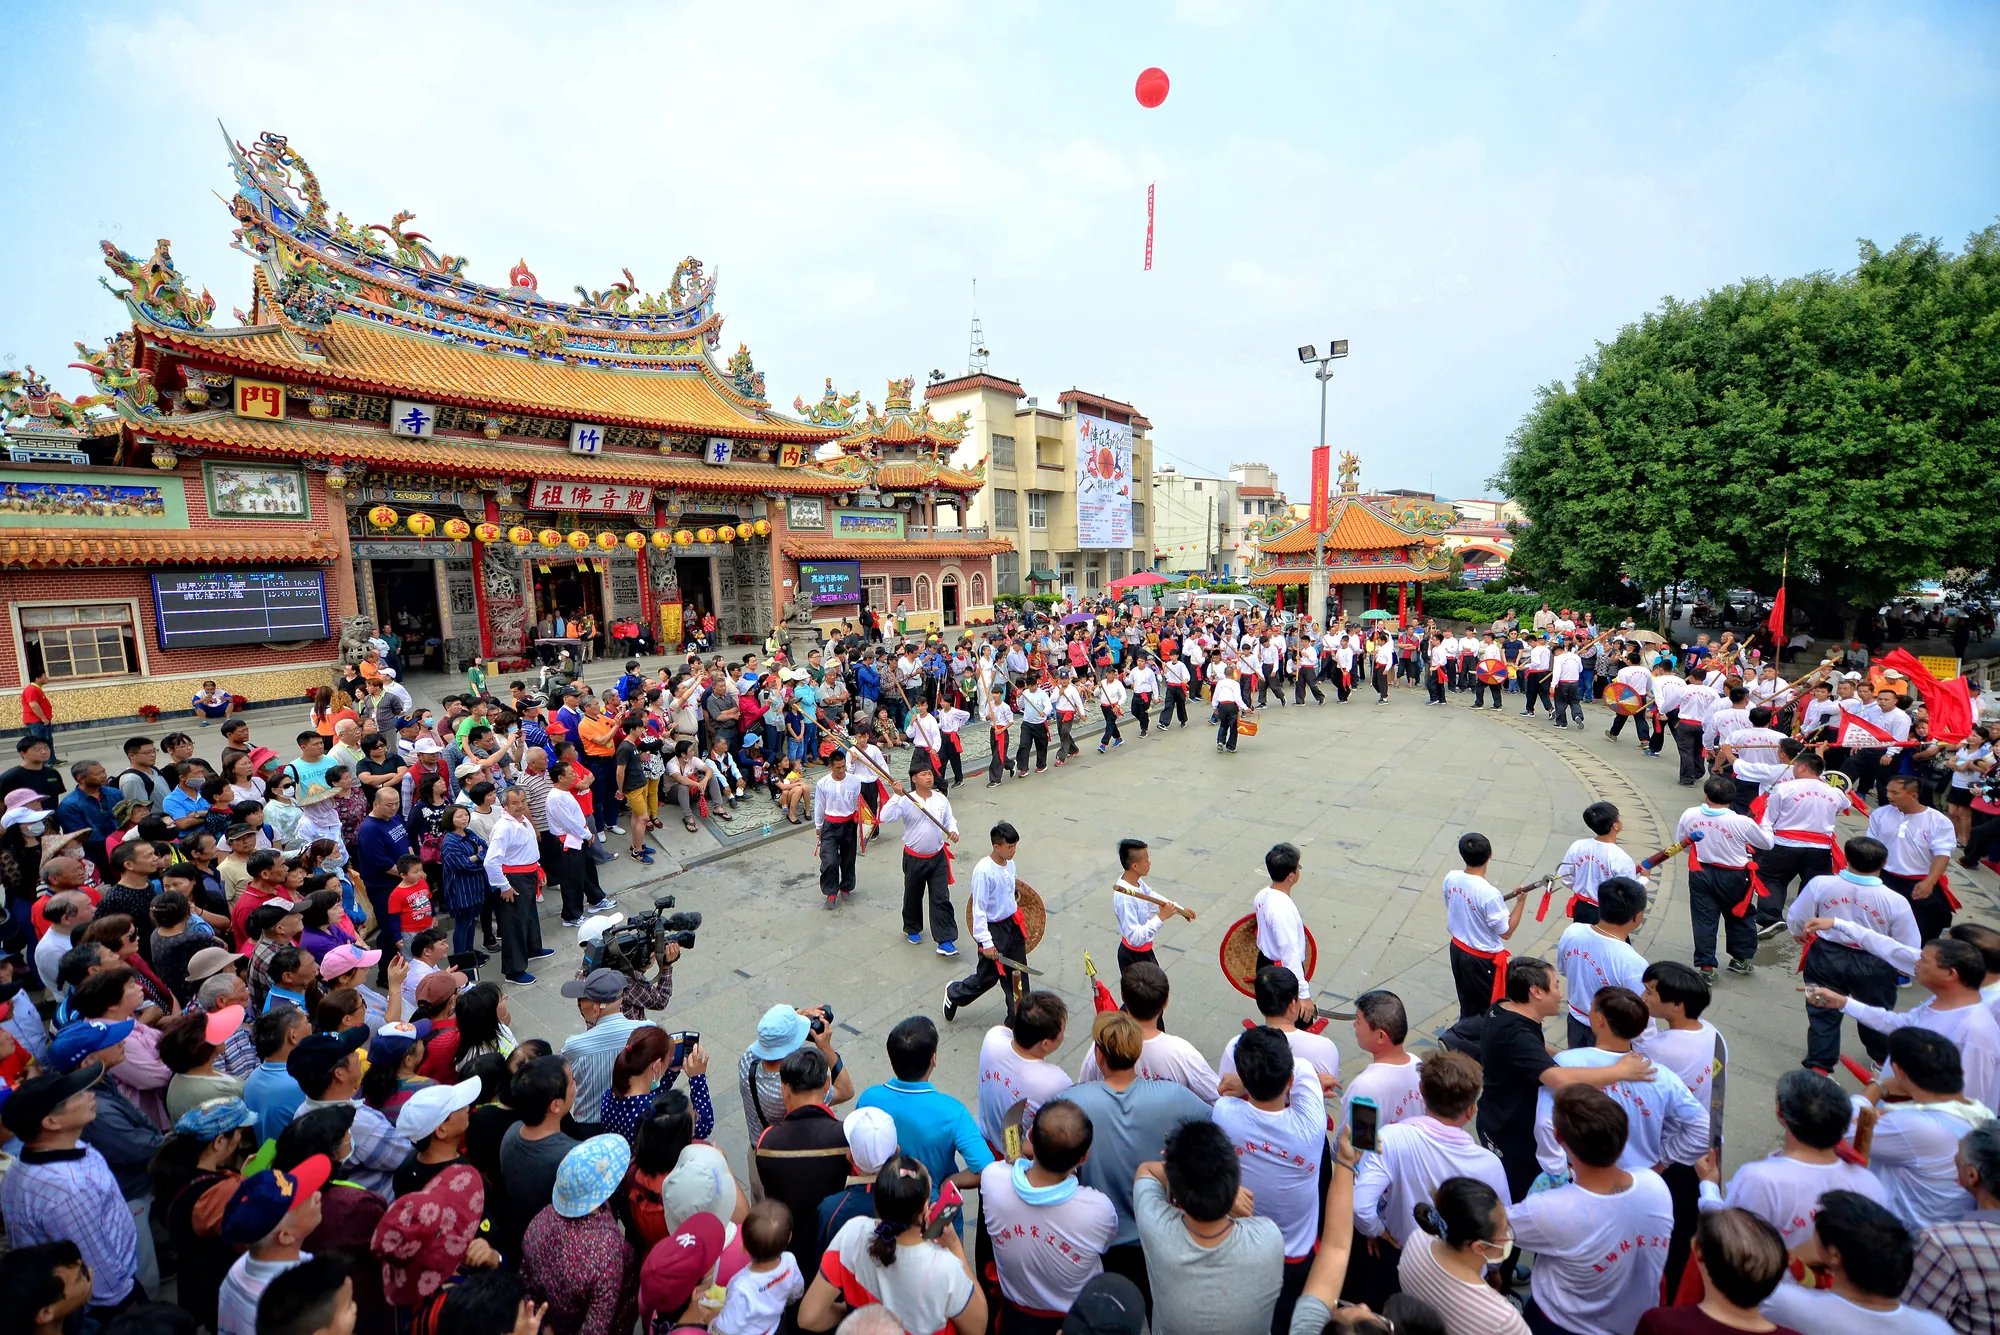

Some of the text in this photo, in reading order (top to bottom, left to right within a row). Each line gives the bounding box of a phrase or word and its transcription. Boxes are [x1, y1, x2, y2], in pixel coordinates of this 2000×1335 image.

[240, 386, 282, 418] 門
[400, 407, 431, 435] 寺
[579, 429, 600, 453] 竹
[712, 442, 730, 463] 紫
[783, 447, 799, 466] 內
[376, 508, 394, 524] 秋
[415, 516, 431, 530] 千
[451, 520, 469, 534] 誕
[481, 525, 498, 540] 聖
[516, 529, 531, 541] 祖
[546, 532, 561, 544] 佛
[574, 533, 588, 547] 音
[604, 534, 616, 547] 觀
[634, 534, 644, 546] 寺
[660, 533, 671, 545] 竹
